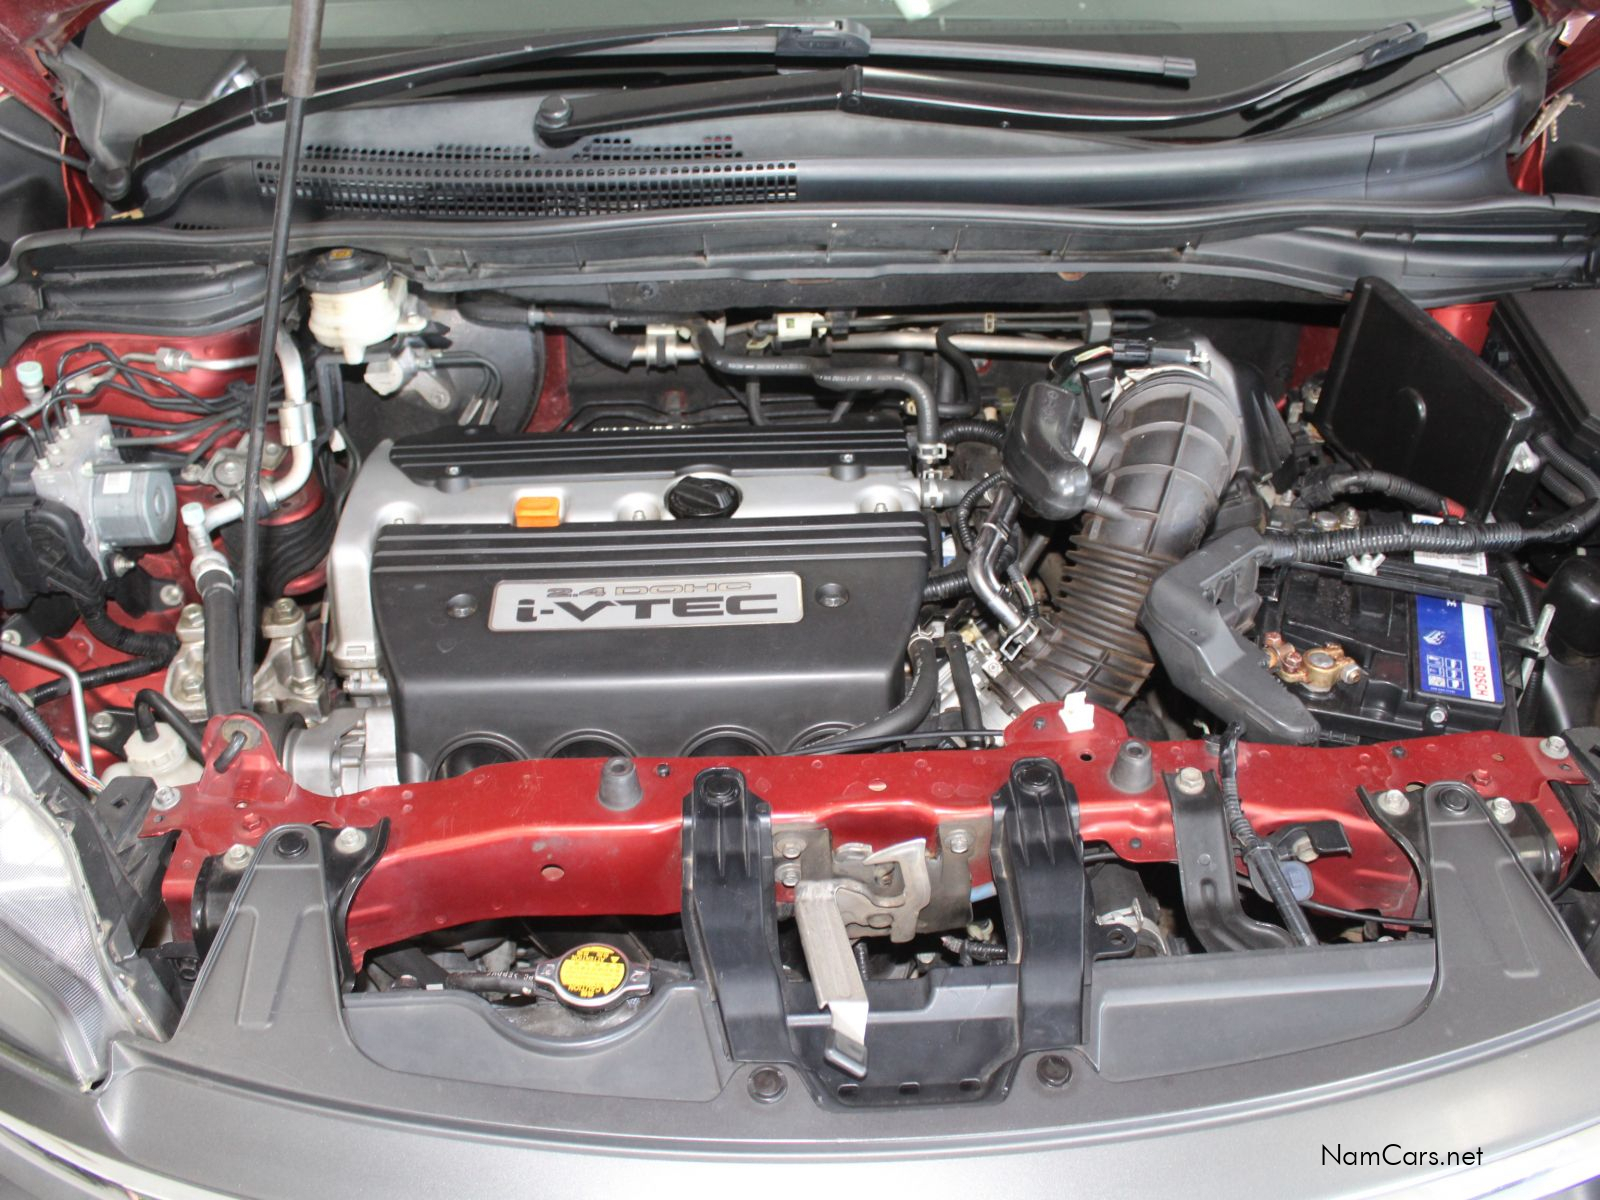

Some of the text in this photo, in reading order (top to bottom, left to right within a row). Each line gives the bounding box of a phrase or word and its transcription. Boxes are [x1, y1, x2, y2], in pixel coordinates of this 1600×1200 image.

[547, 581, 752, 597] 2.4 DOHC
[516, 593, 778, 623] i-VTEC
[1472, 664, 1489, 697] BOSCH
